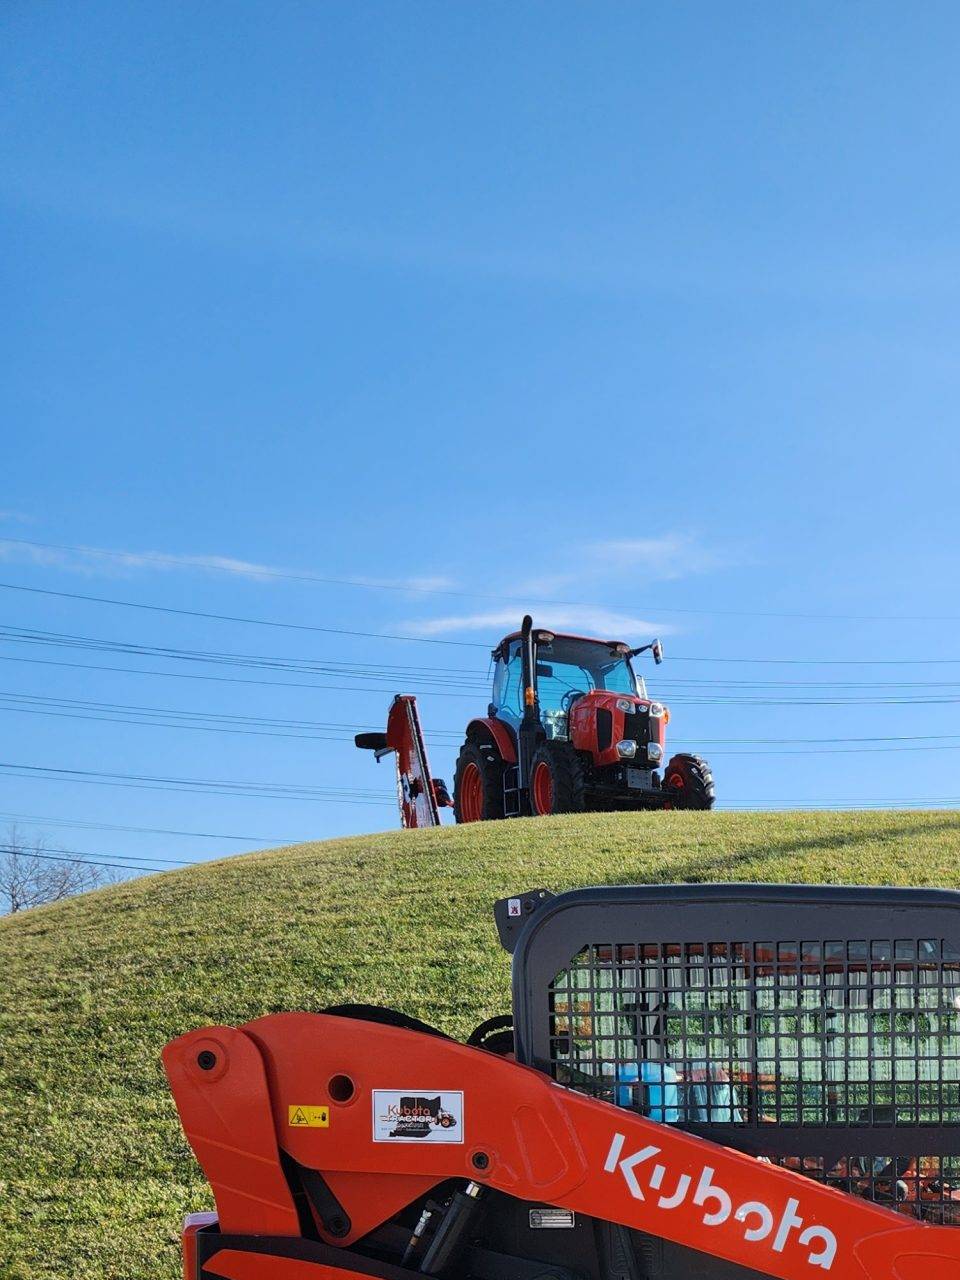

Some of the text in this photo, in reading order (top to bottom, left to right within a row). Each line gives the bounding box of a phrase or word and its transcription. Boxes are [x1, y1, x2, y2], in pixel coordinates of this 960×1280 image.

[387, 1104, 431, 1115] Kubota
[387, 1115, 432, 1123] TRACTOR
[603, 1132, 838, 1270] Kubota
